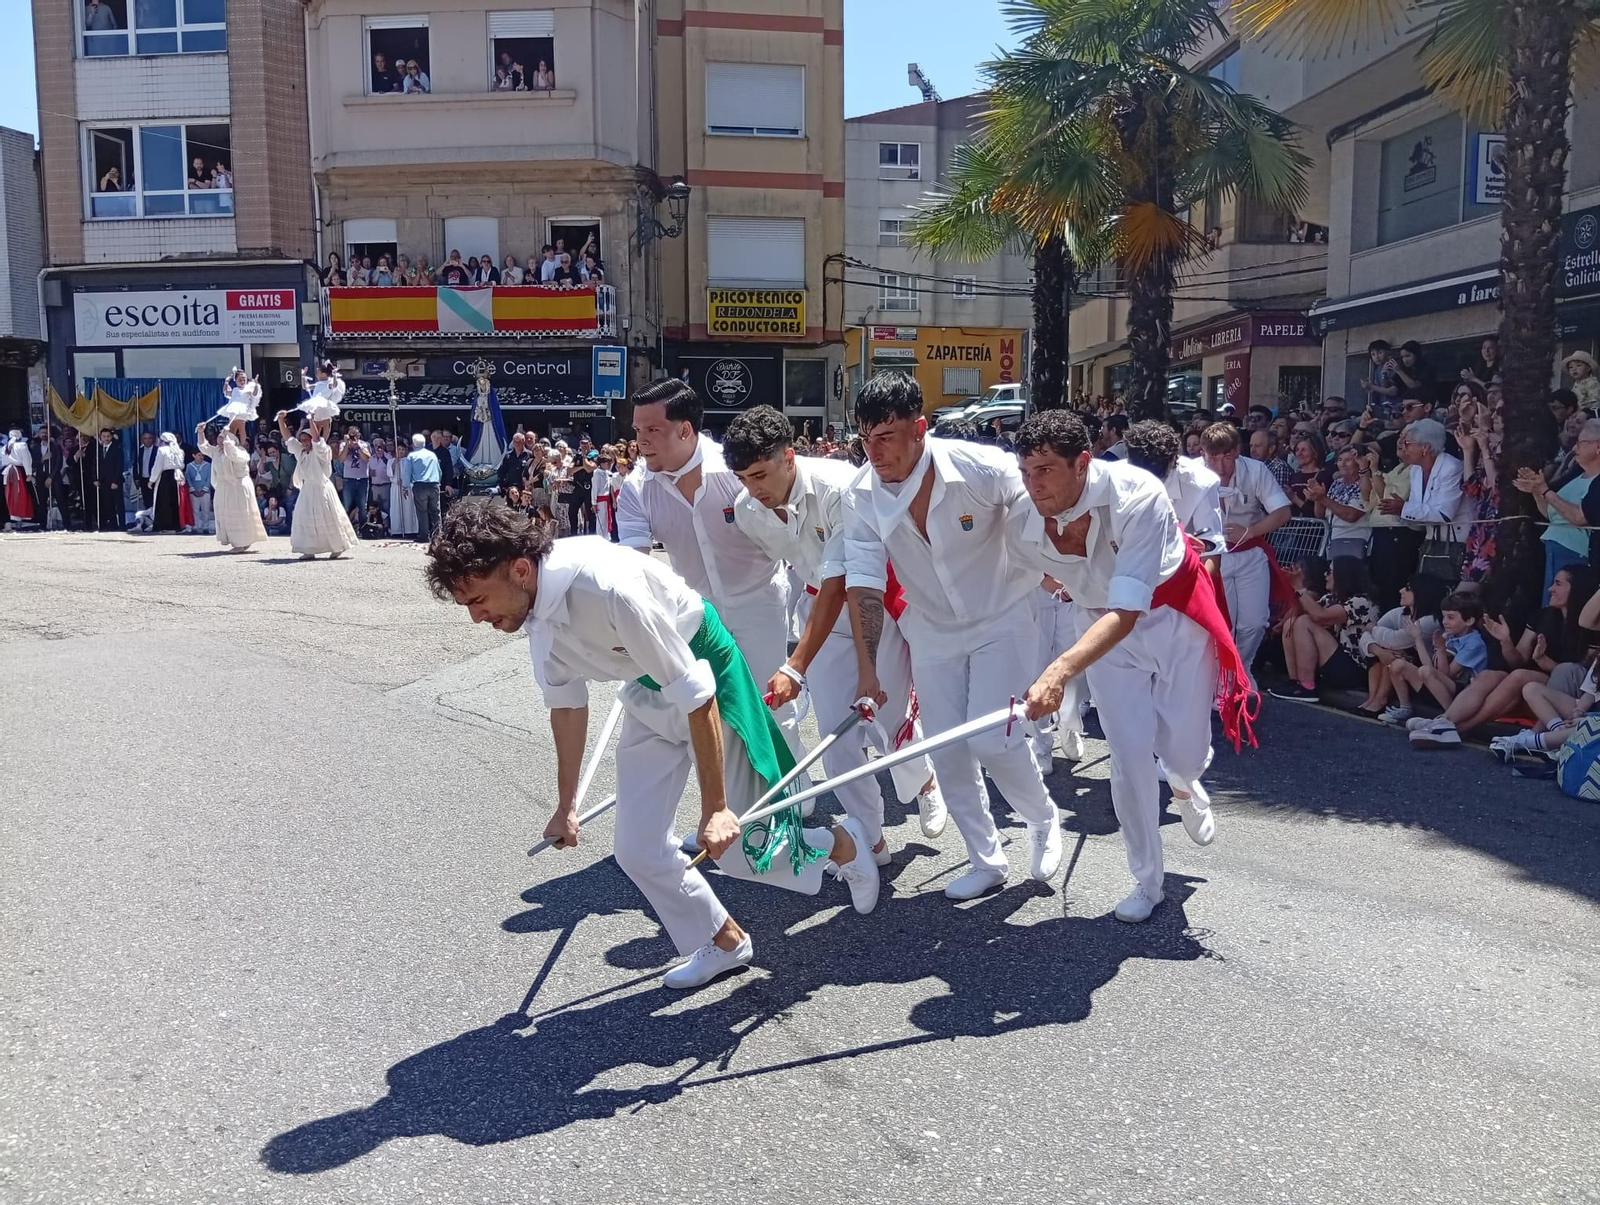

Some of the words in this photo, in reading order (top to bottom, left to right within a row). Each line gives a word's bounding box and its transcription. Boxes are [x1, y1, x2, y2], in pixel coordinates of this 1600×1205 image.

[1564, 250, 1600, 270] Estrell
[239, 294, 282, 307] GRATIS
[710, 291, 803, 305] PSICOTECNICO
[105, 295, 219, 327] escoita
[717, 306, 796, 318] REDONDELA
[713, 320, 801, 333] CONDUCTORES
[1260, 324, 1306, 336] PAPELE
[121, 330, 170, 339] especialistas
[926, 343, 992, 361] ZAPATERÍA
[503, 360, 571, 375] Central
[1000, 338, 1014, 384] MOS
[285, 370, 294, 382] 6
